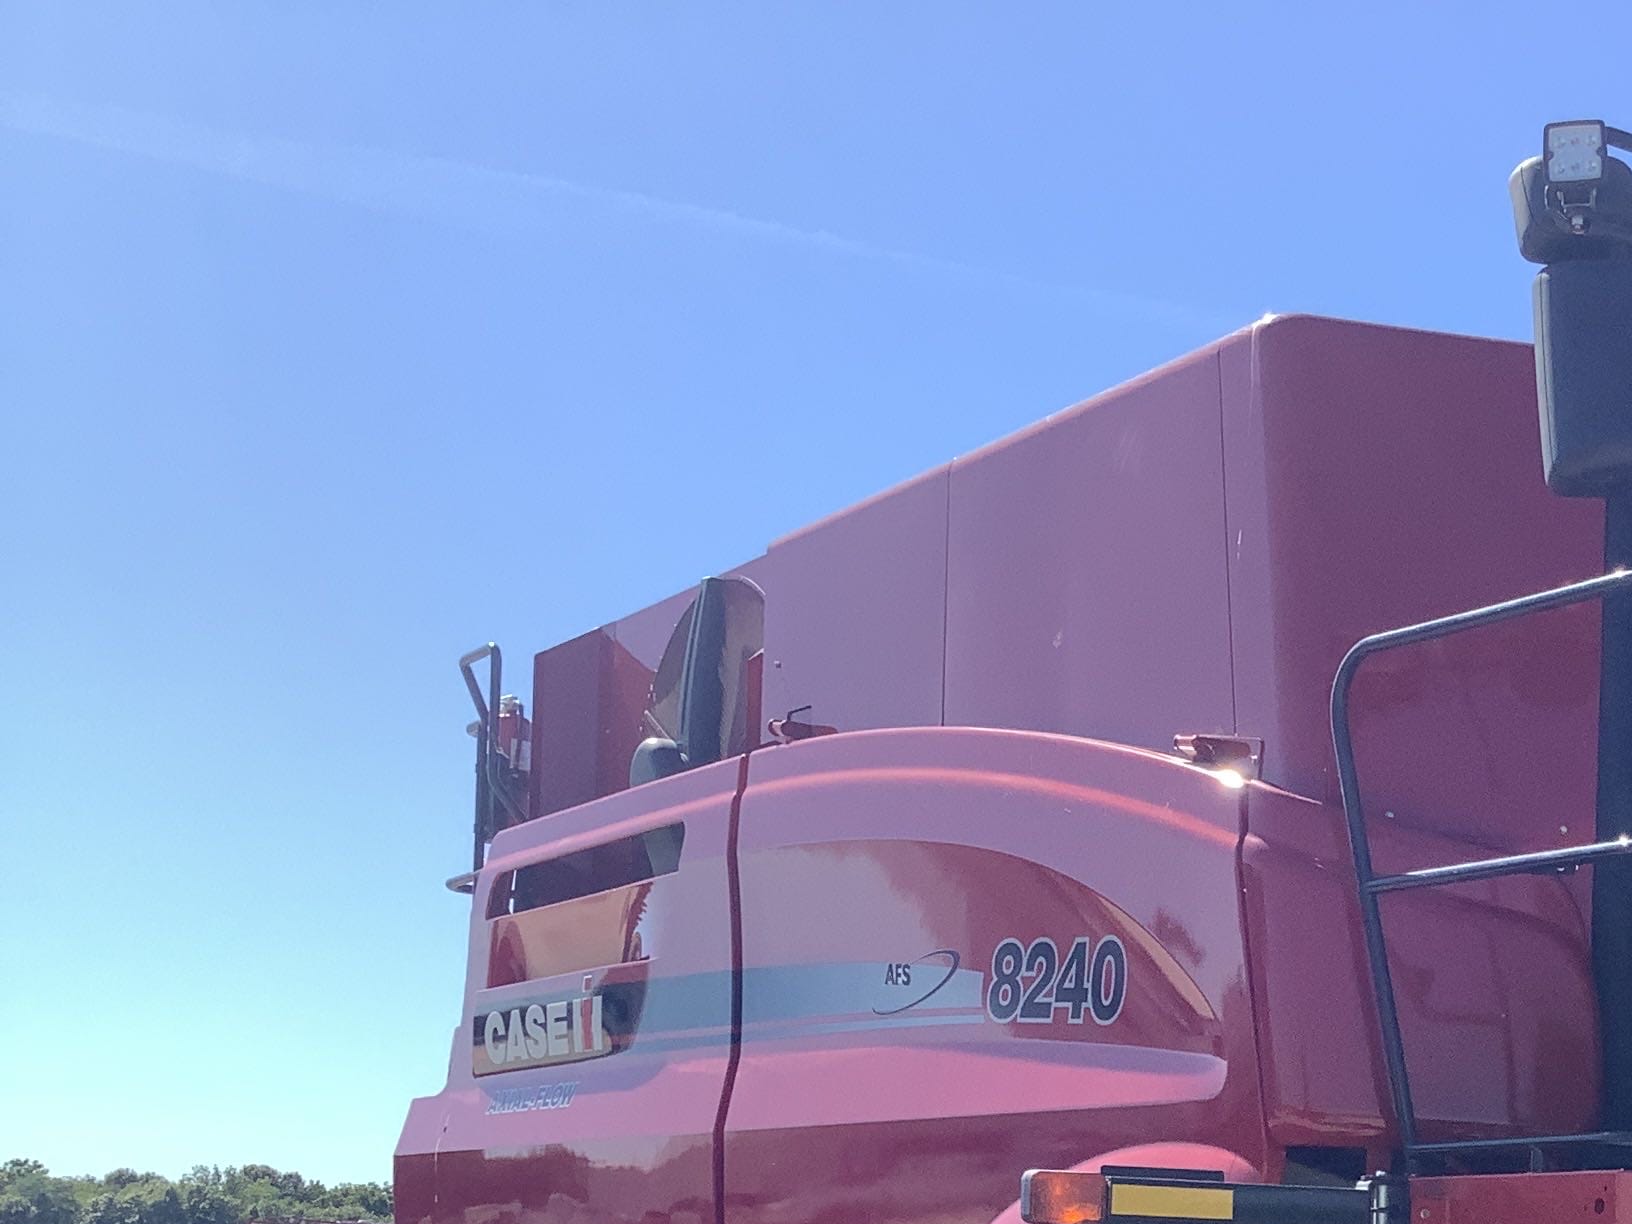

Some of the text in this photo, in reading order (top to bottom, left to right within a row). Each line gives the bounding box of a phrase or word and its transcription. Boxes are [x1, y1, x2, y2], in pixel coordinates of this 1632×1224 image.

[885, 964, 911, 986] AFS
[987, 934, 1128, 1026] 8240
[484, 1001, 570, 1065] CASE
